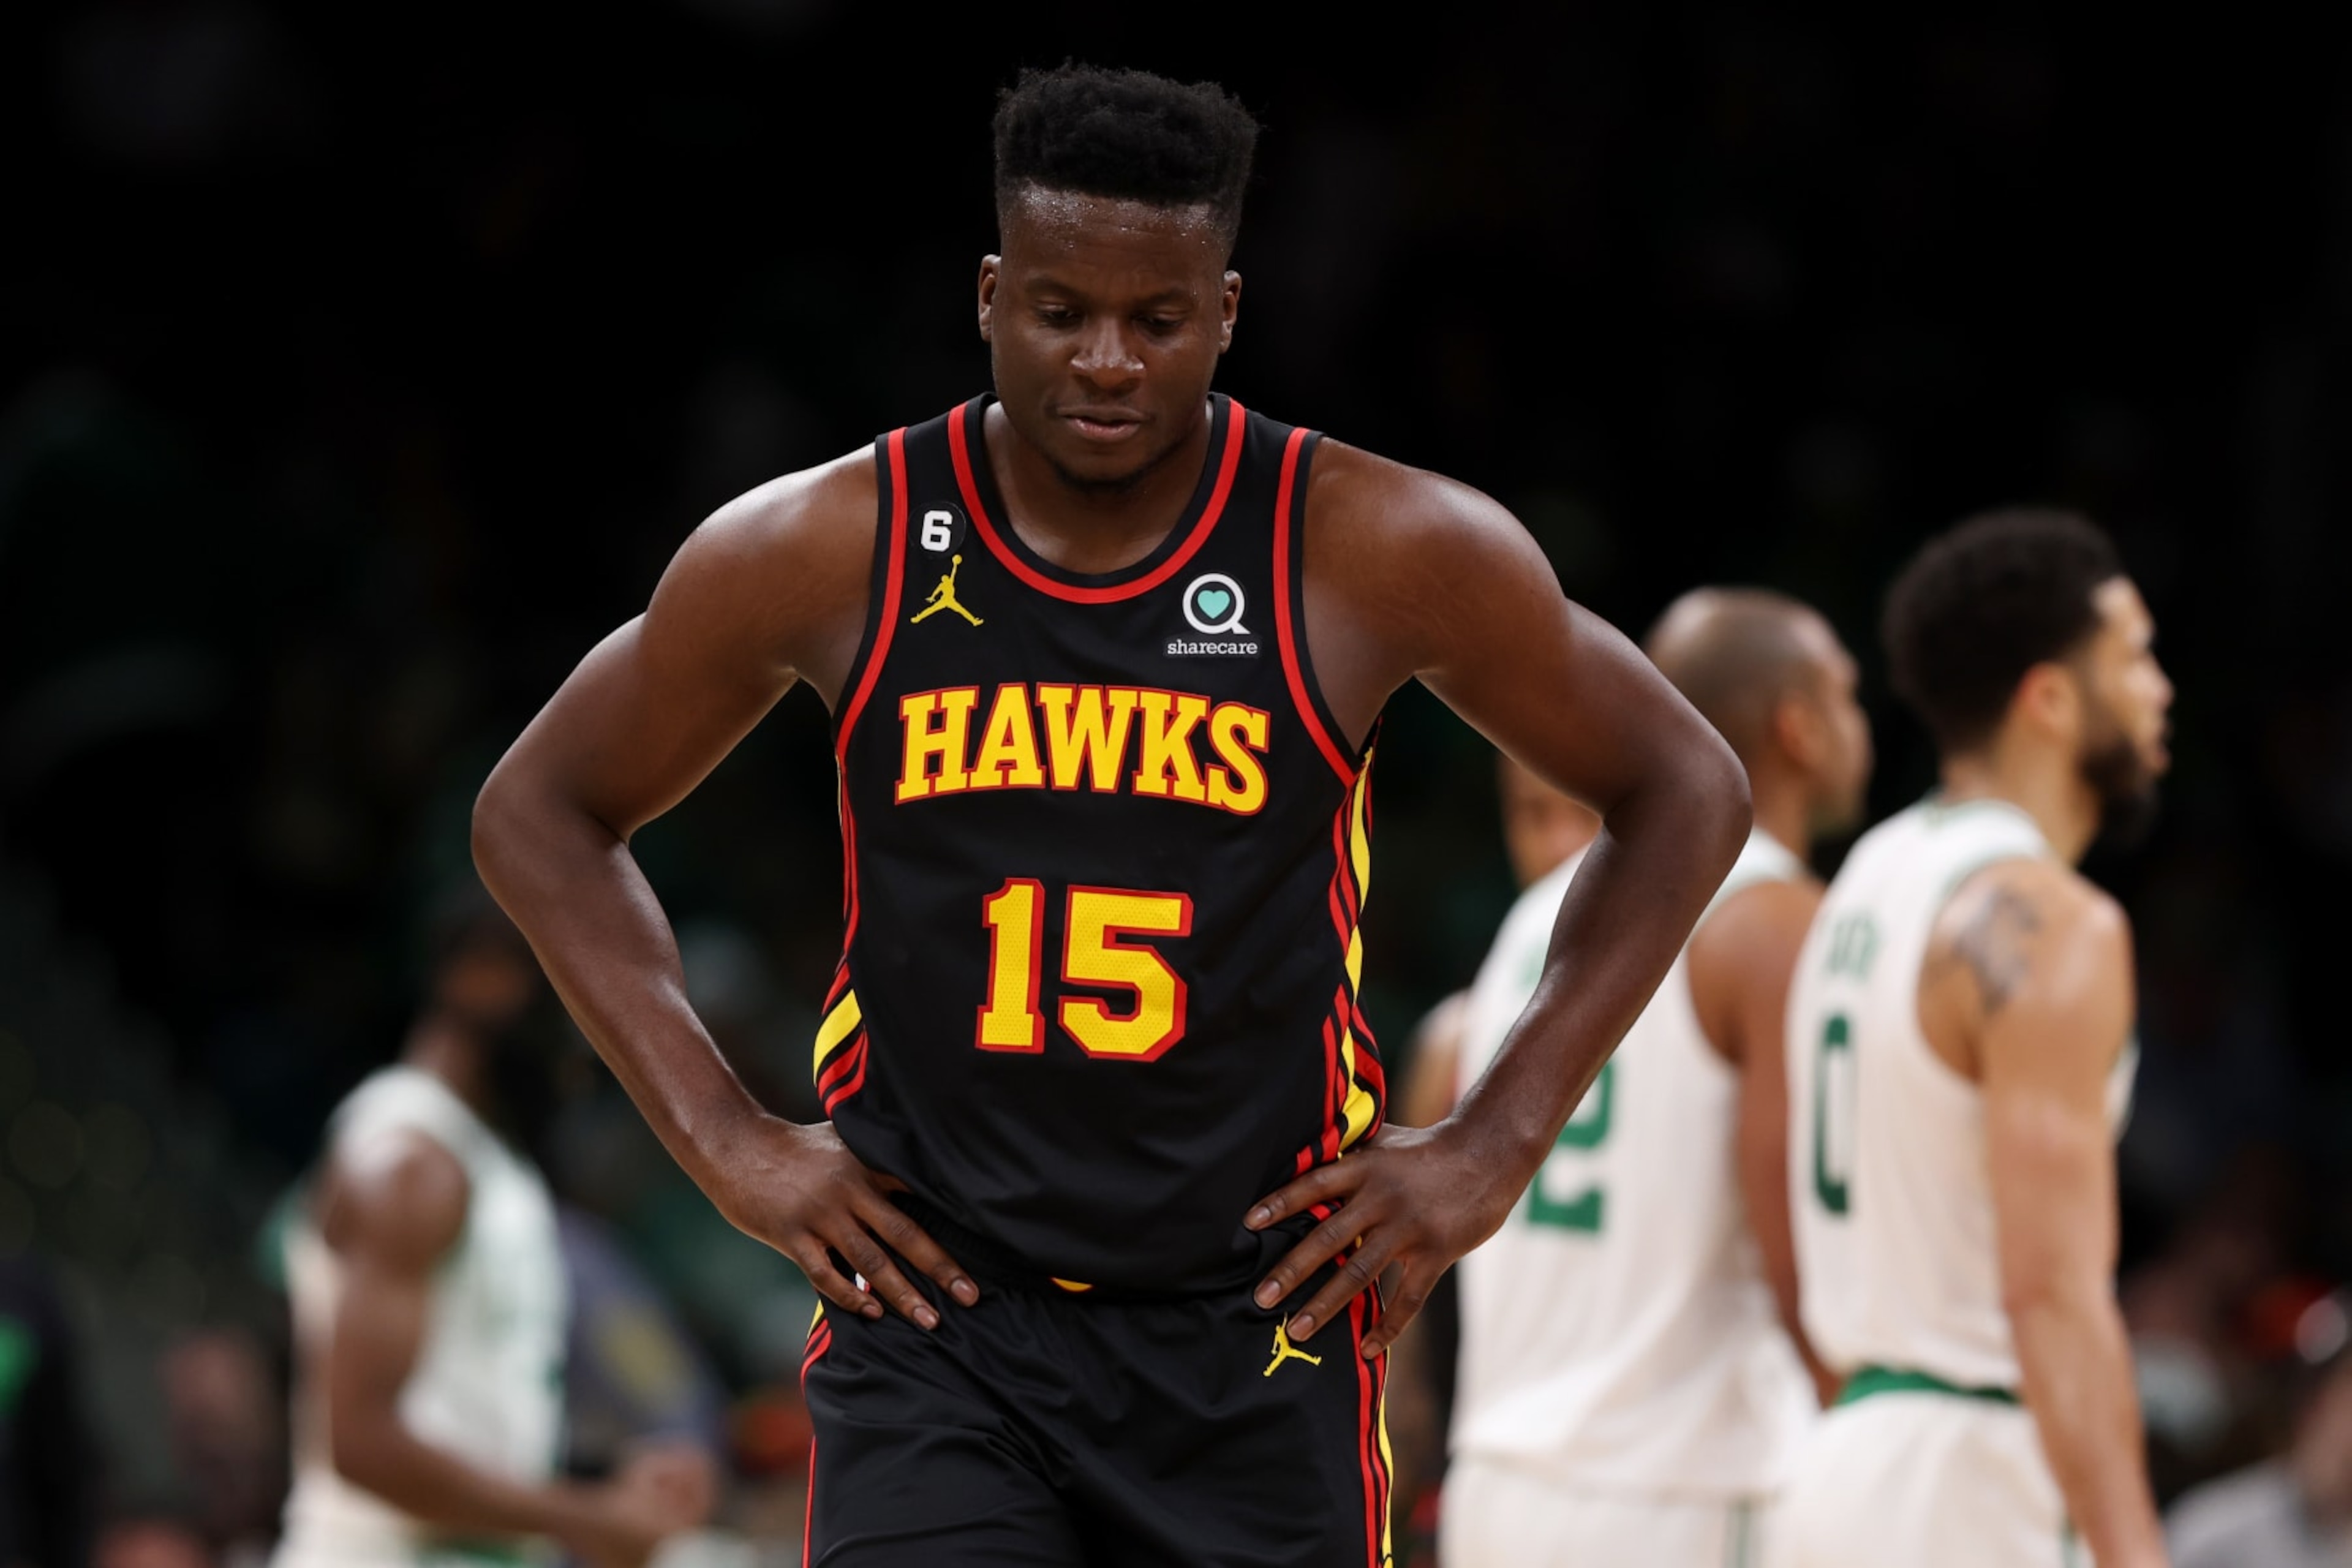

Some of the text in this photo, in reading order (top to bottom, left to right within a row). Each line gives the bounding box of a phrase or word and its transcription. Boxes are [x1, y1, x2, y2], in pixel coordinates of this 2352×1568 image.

[921, 510, 953, 552] 6
[1167, 638, 1258, 655] sharecare
[894, 681, 1272, 817] HAWKS
[974, 876, 1195, 1063] 15
